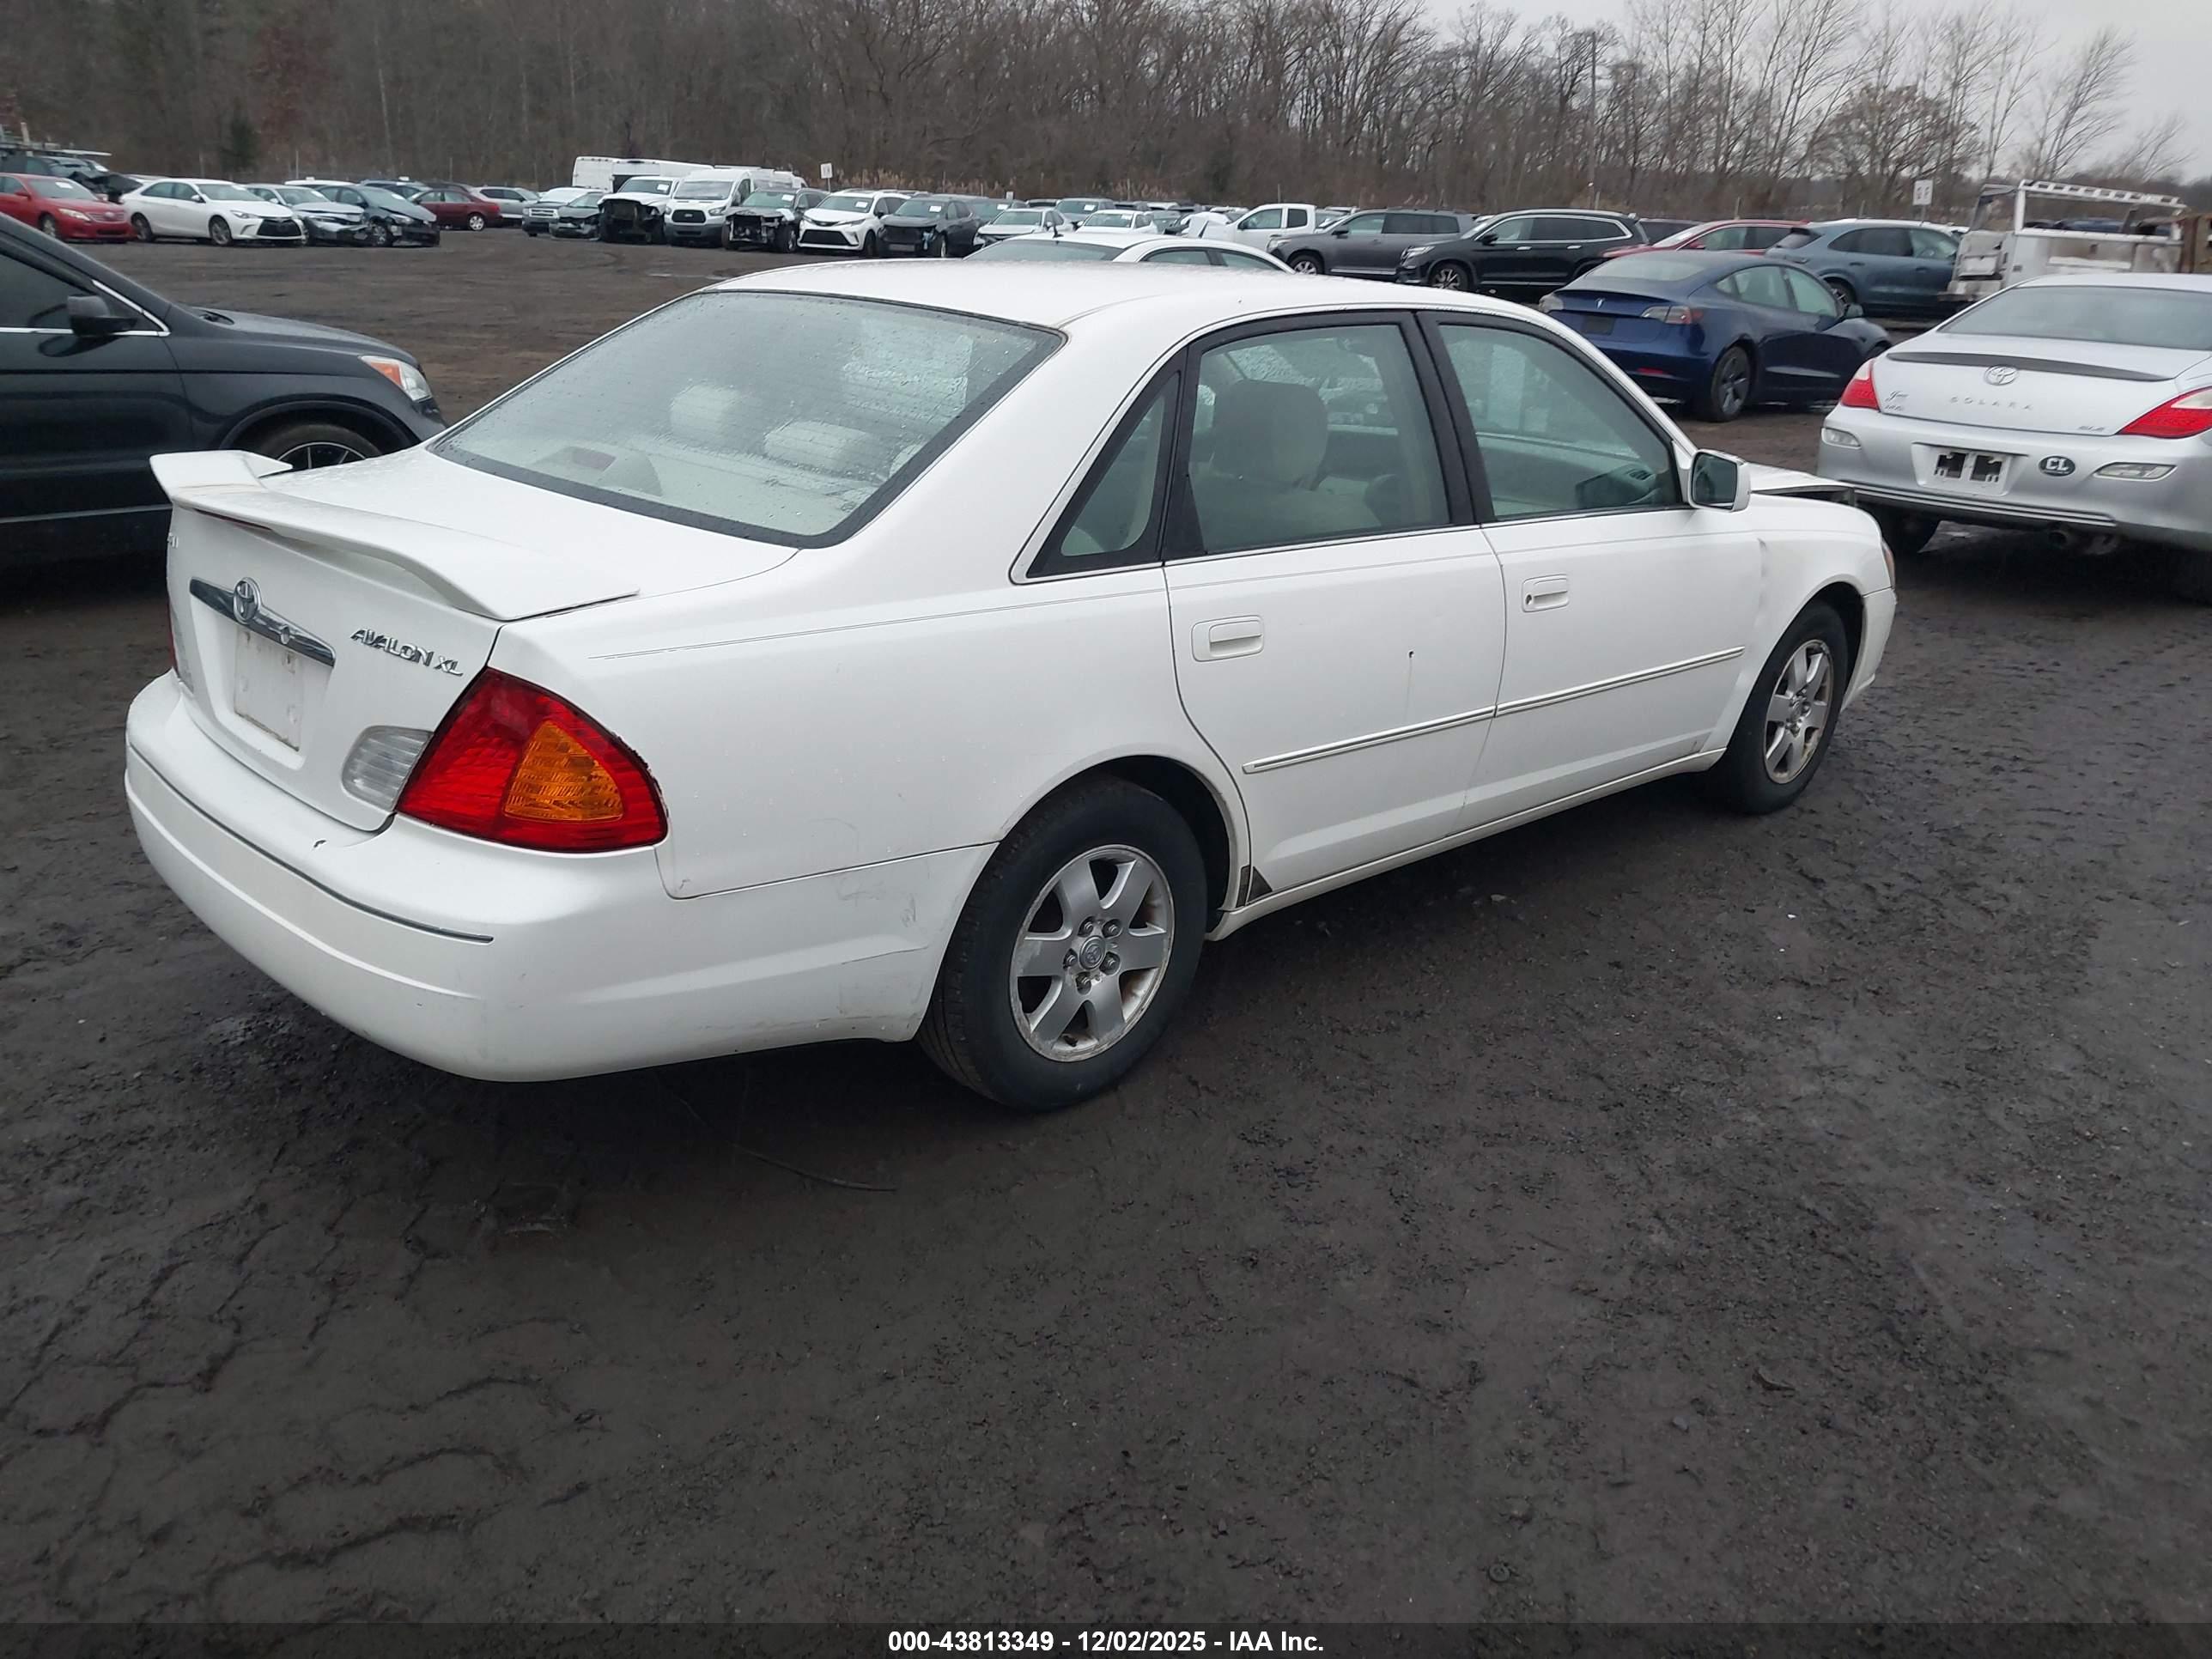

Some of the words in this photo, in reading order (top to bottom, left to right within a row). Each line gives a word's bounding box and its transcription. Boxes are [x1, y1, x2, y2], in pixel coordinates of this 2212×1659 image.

[1950, 396, 2032, 410] SOLARA
[2045, 457, 2069, 471] CL
[350, 629, 434, 666] AVALON
[433, 655, 464, 677] XL
